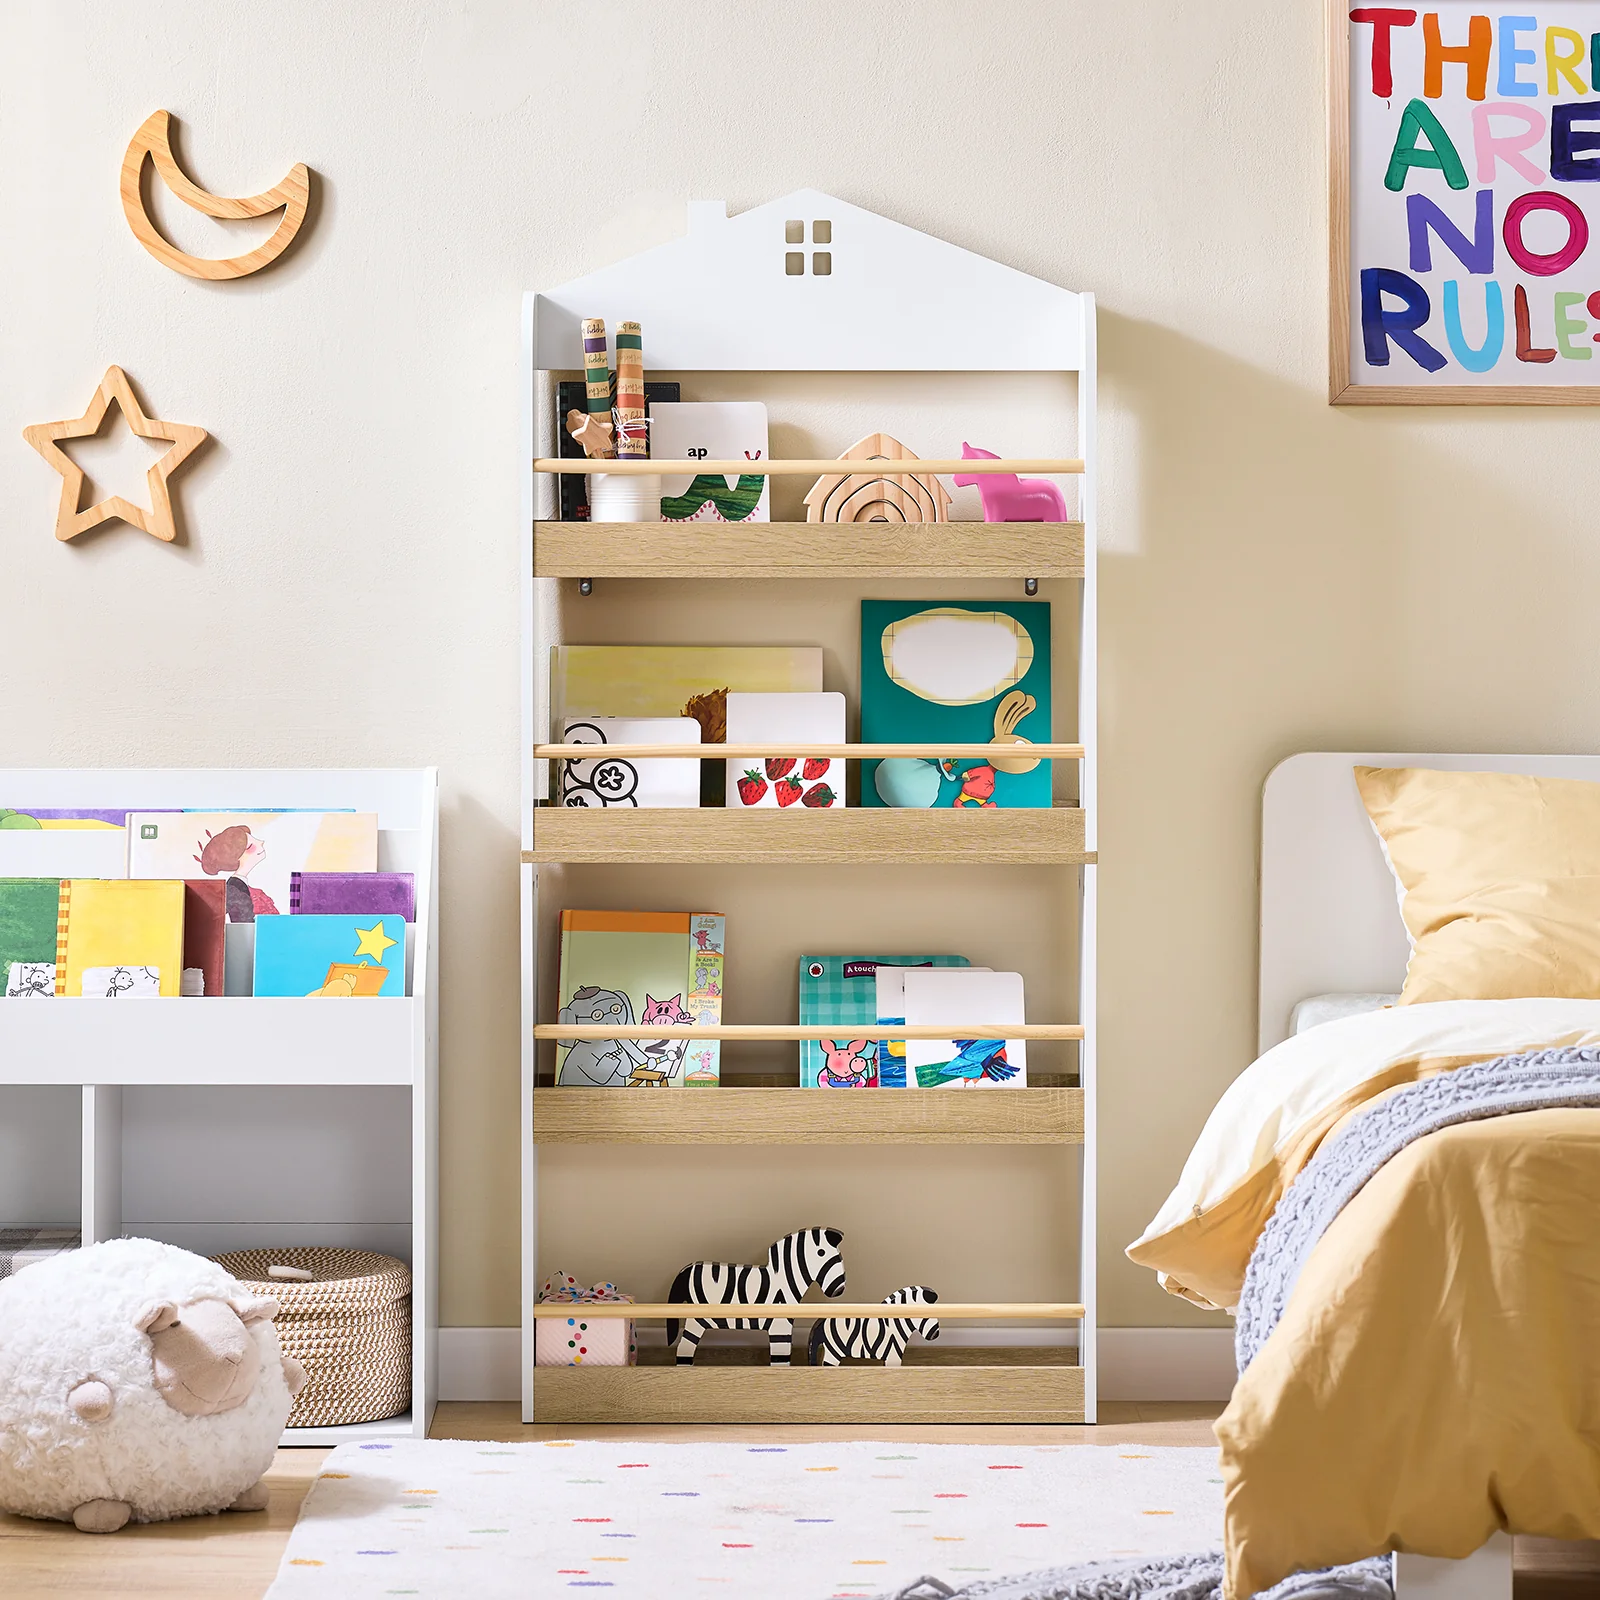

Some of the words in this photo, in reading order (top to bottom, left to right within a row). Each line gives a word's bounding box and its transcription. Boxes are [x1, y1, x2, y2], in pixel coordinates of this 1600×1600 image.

[1349, 8, 1600, 101] THER
[1384, 97, 1600, 191] ARE
[1406, 189, 1589, 276] NO
[687, 447, 708, 460] ap
